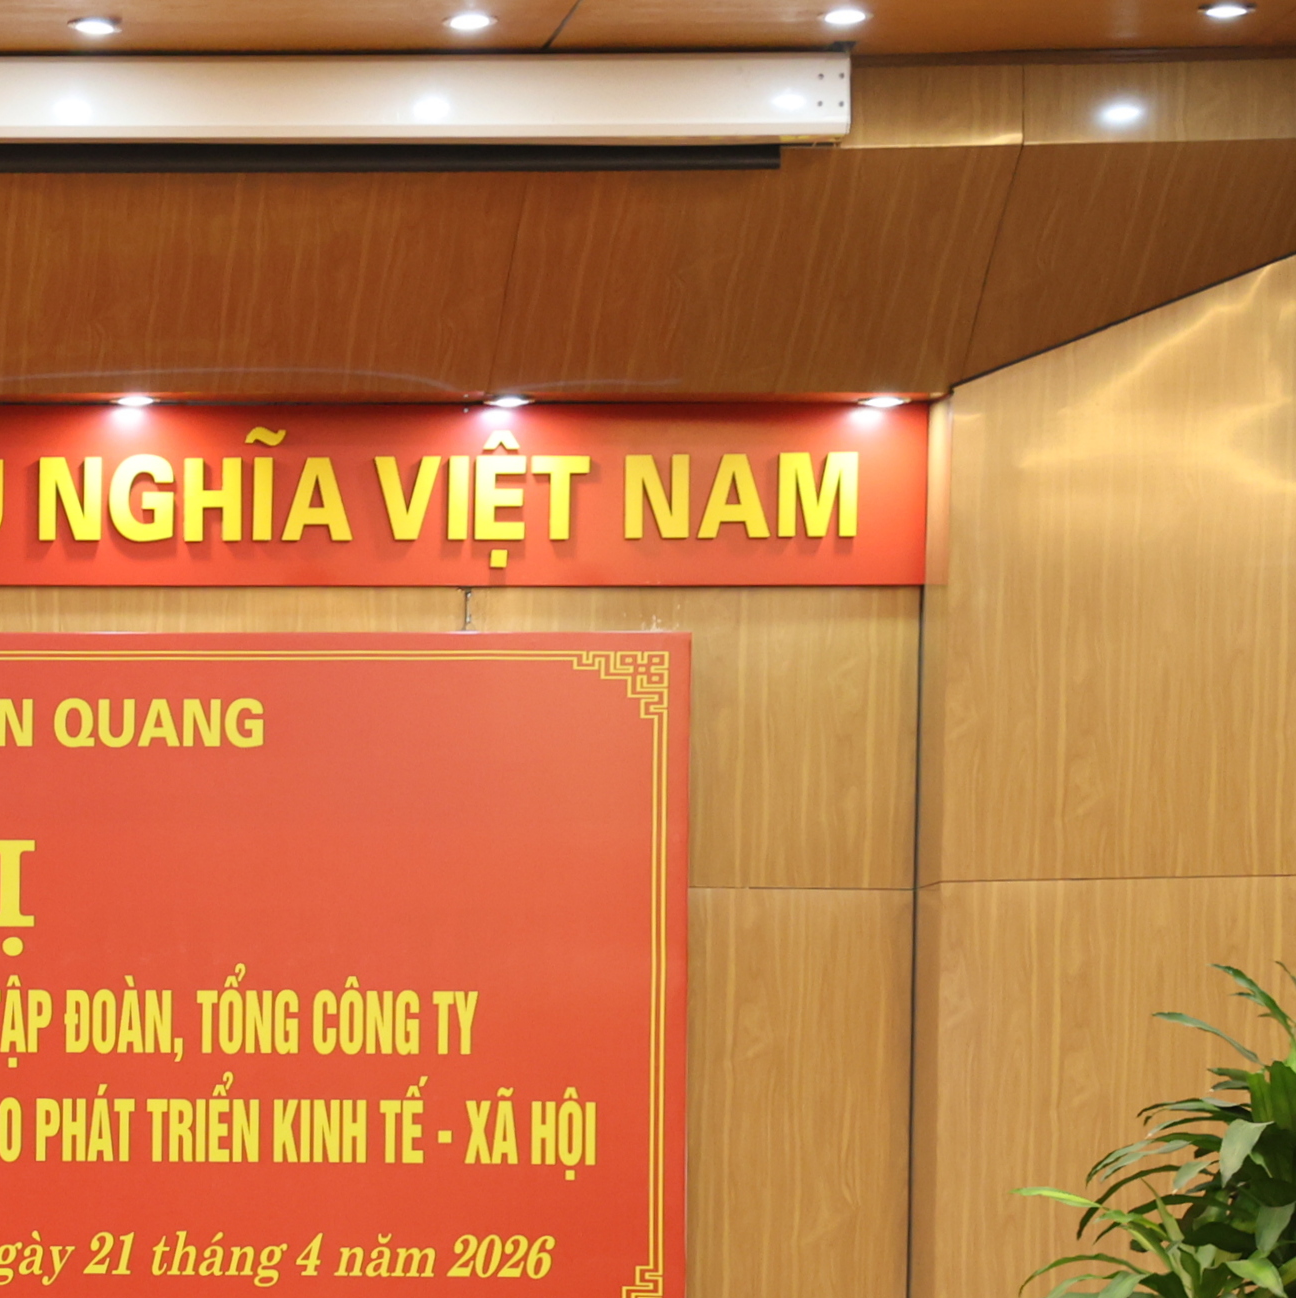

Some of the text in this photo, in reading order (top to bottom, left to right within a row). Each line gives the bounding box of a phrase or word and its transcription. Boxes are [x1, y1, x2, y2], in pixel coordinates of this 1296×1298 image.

[39, 428, 353, 541] NGHĨA
[375, 435, 591, 568] VIỆT
[624, 450, 859, 538] NAM
[54, 698, 264, 749] QUANG
[64, 975, 183, 1062] ĐOÀN,
[197, 963, 299, 1054] TỔNG
[313, 976, 420, 1055] CÔNG
[433, 991, 478, 1055] TY
[36, 1084, 135, 1162] PHÁT
[147, 1072, 259, 1162] TRIỂN
[273, 1099, 367, 1163] KINH
[380, 1076, 428, 1163] TẾ
[438, 1130, 452, 1143] -
[465, 1087, 518, 1164] XÃ
[531, 1087, 596, 1180] HỘI
[83, 1232, 134, 1275] 21
[152, 1231, 287, 1287] tháng
[296, 1233, 323, 1277] 4
[334, 1234, 435, 1278] năm
[447, 1234, 555, 1280] 2026
